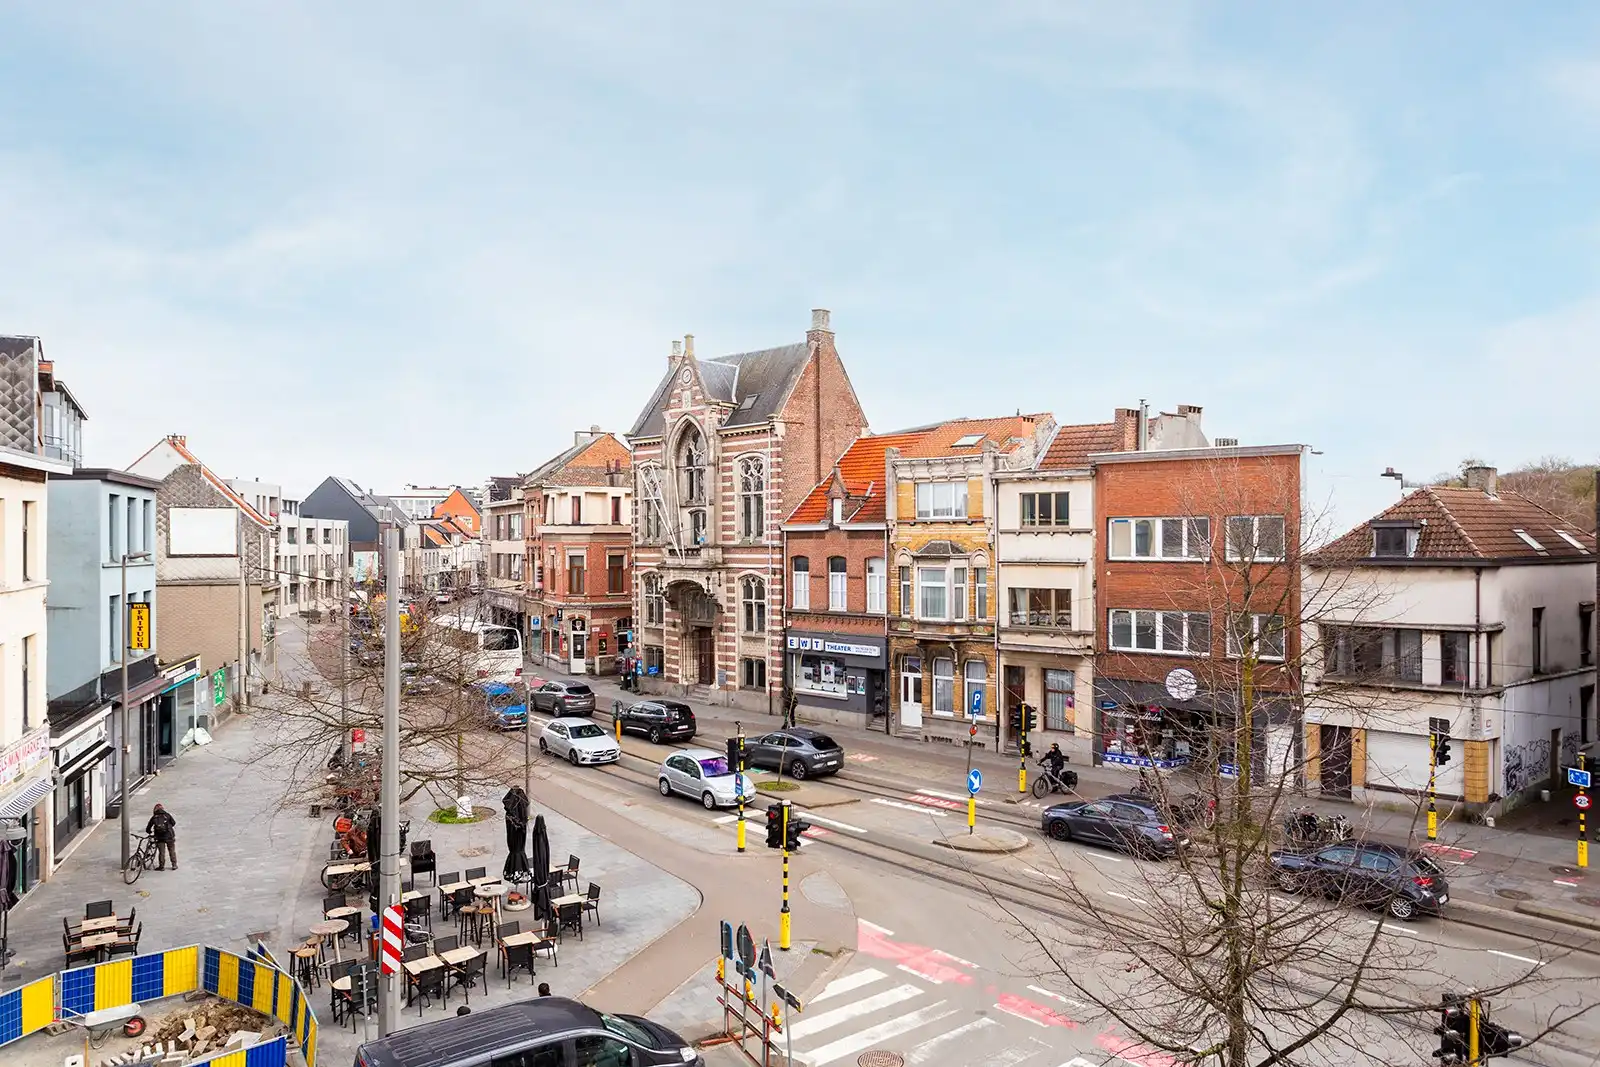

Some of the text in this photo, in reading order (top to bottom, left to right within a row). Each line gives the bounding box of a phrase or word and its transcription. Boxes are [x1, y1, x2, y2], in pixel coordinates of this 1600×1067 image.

[136, 609, 144, 648] FRITUUR
[826, 644, 852, 652] THEATER
[974, 693, 981, 706] P
[8, 748, 21, 768] MINI
[22, 736, 42, 760] MARKET
